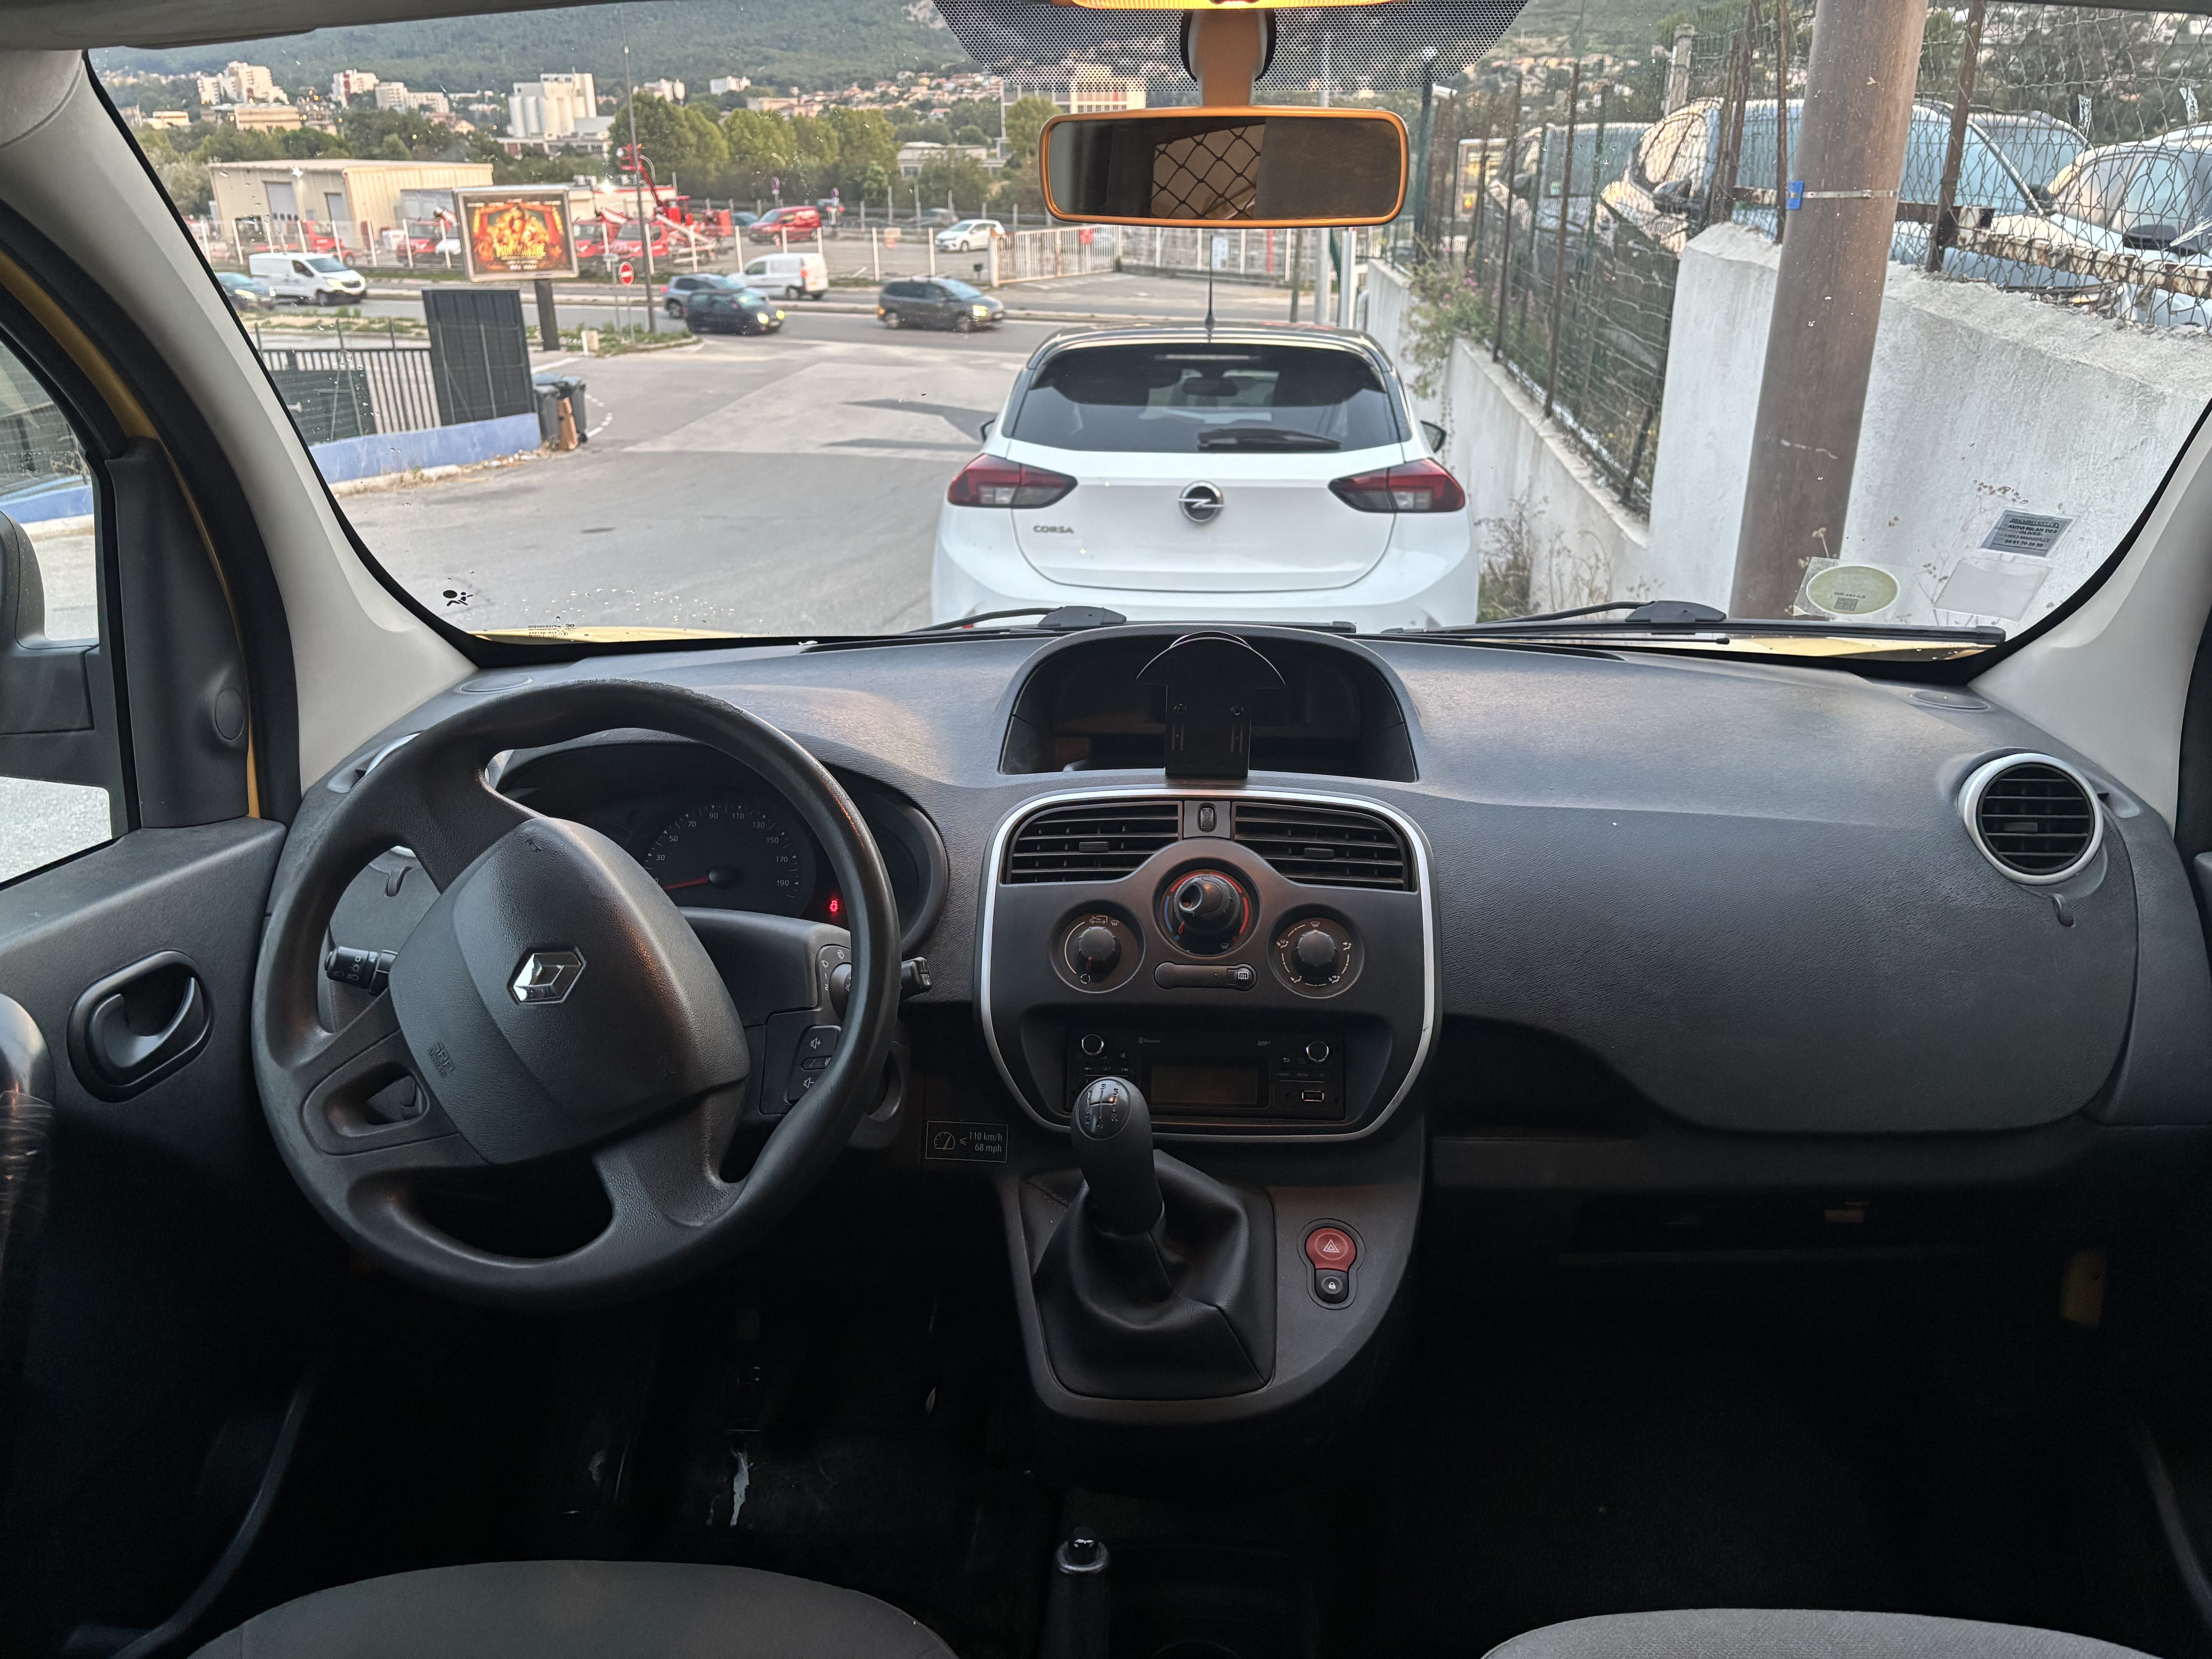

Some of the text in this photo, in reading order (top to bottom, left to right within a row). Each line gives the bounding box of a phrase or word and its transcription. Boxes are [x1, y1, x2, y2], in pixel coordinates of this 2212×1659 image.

[1033, 525, 1074, 534] CORSA
[1111, 1113, 1118, 1121] R
[969, 1132, 982, 1140] 110
[984, 1132, 1002, 1141] km/h
[975, 1143, 1002, 1154] 68 mph
